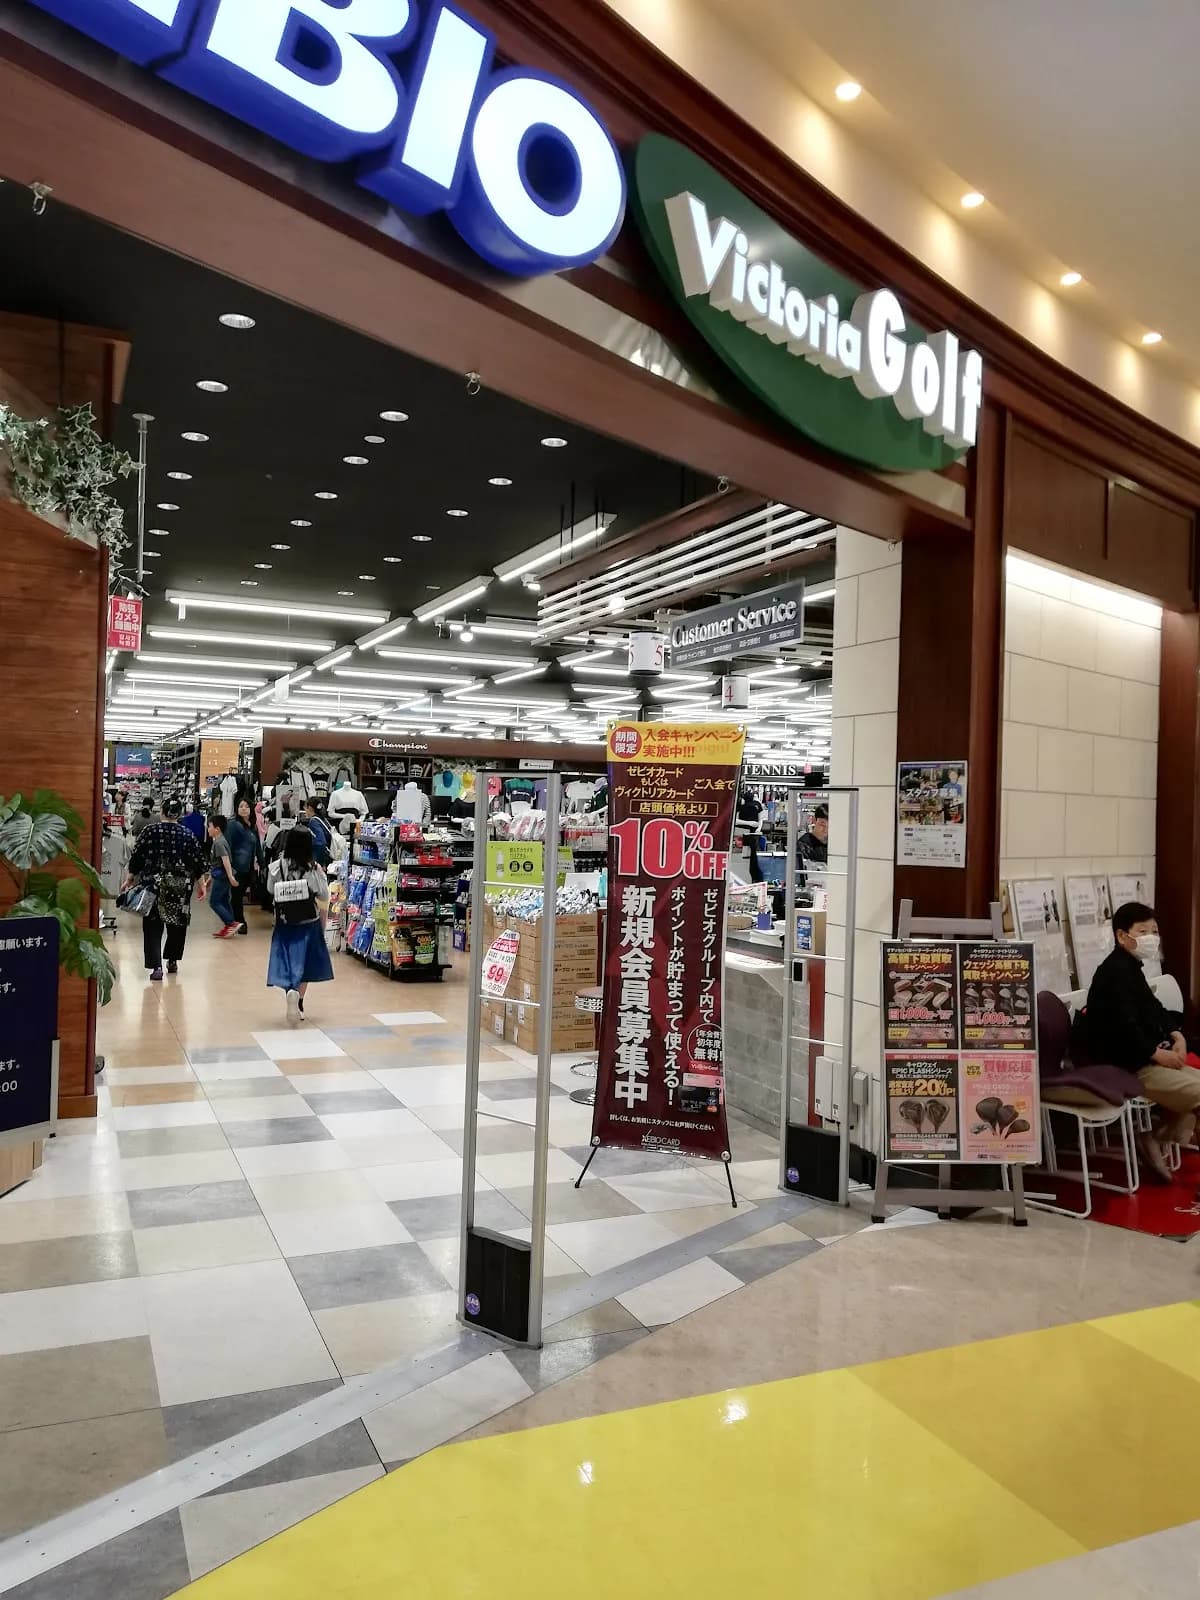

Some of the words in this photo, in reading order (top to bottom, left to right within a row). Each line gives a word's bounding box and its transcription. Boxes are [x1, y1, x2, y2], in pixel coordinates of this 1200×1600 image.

[32, 0, 627, 272] BIO
[664, 191, 862, 378] Victoria
[850, 288, 983, 448] Golf
[115, 612, 139, 622] カメラ
[671, 617, 735, 648] Customer
[737, 597, 797, 632] Service
[654, 645, 663, 666] 5
[724, 685, 734, 701] 4
[615, 731, 637, 742] 期間
[643, 729, 744, 743] 入会キャンペーン
[368, 738, 428, 752] Champion
[615, 742, 637, 754] 限定
[626, 766, 684, 778] ゼビオカード
[742, 764, 797, 776] TENNIS
[641, 777, 669, 786] もしくは
[694, 779, 735, 791] ご入会で
[614, 786, 695, 800] ヴィクトリアカード
[639, 803, 708, 815] 店頭価格より
[683, 850, 730, 880] OFF
[699, 888, 719, 1023] ゼビオグループ内で
[963, 970, 1030, 980] 買取キャンペーン
[0, 981, 16, 994] す。
[614, 885, 656, 1109] 新規会員募集中
[696, 1038, 721, 1049] 初年度
